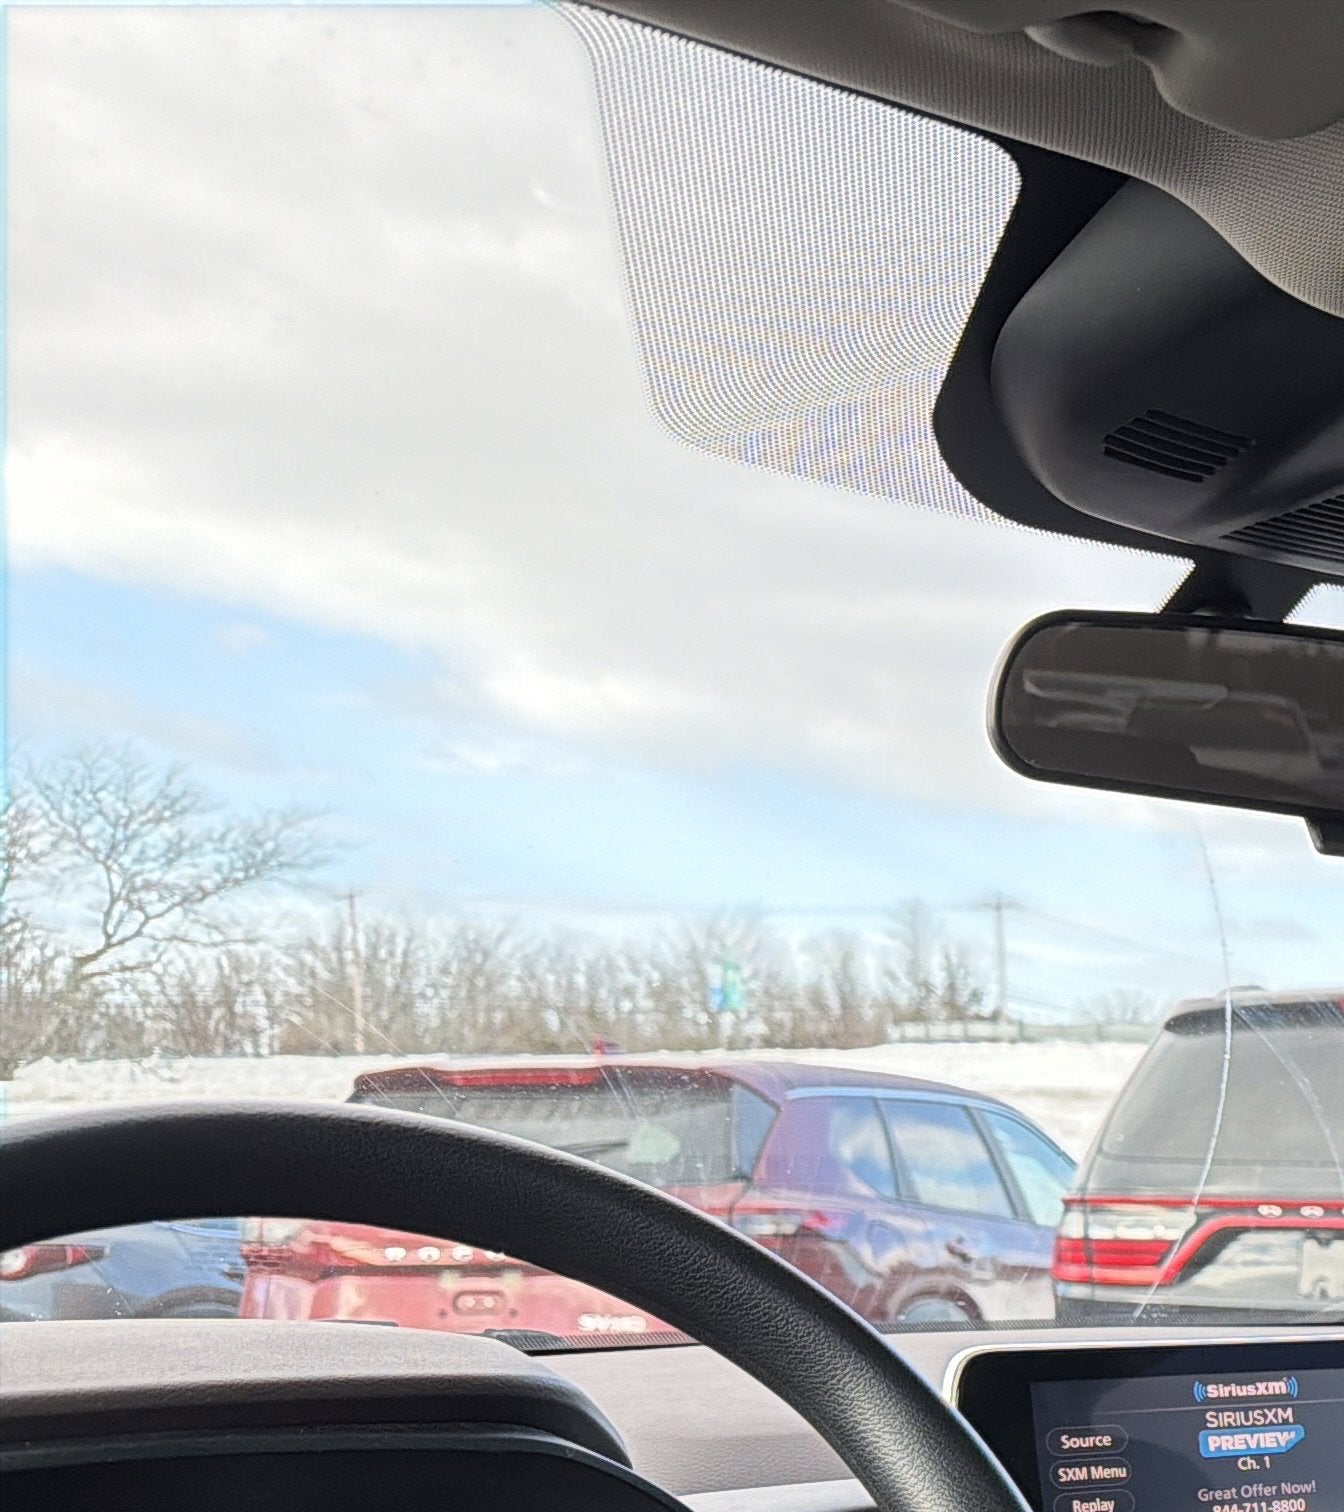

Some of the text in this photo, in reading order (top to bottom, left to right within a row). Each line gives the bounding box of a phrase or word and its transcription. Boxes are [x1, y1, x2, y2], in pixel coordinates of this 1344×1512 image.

[1205, 1407, 1294, 1428] SIRIUSXM
[1060, 1434, 1112, 1450] Source
[1208, 1431, 1295, 1452] PREVIEW
[1237, 1456, 1271, 1471] Ch. 1
[1057, 1465, 1127, 1482] SXM Menu
[1198, 1480, 1317, 1502] Great Offer Now!
